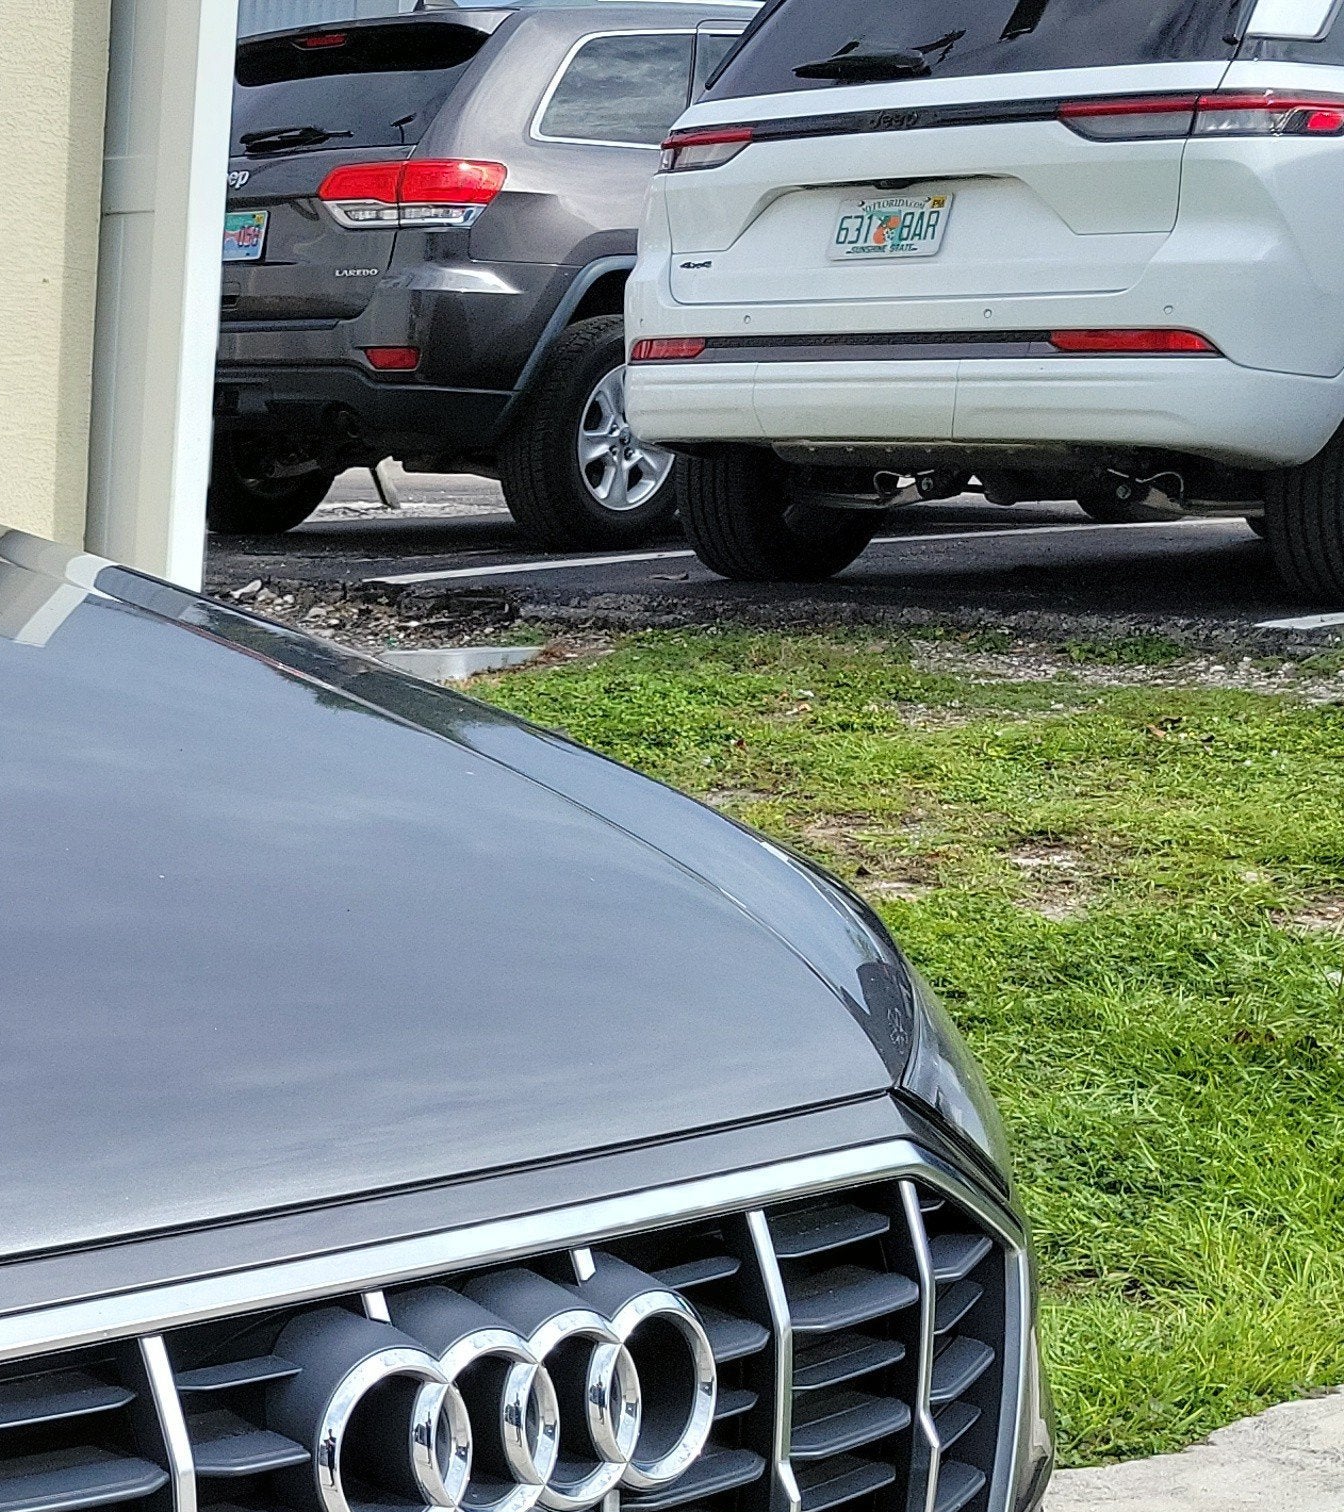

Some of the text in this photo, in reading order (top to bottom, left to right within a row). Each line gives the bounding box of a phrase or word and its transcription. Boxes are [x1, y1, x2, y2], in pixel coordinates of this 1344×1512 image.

[836, 215, 873, 245] 631
[850, 243, 915, 254] SUNSHINE STATE
[335, 268, 379, 277] LAREDO
